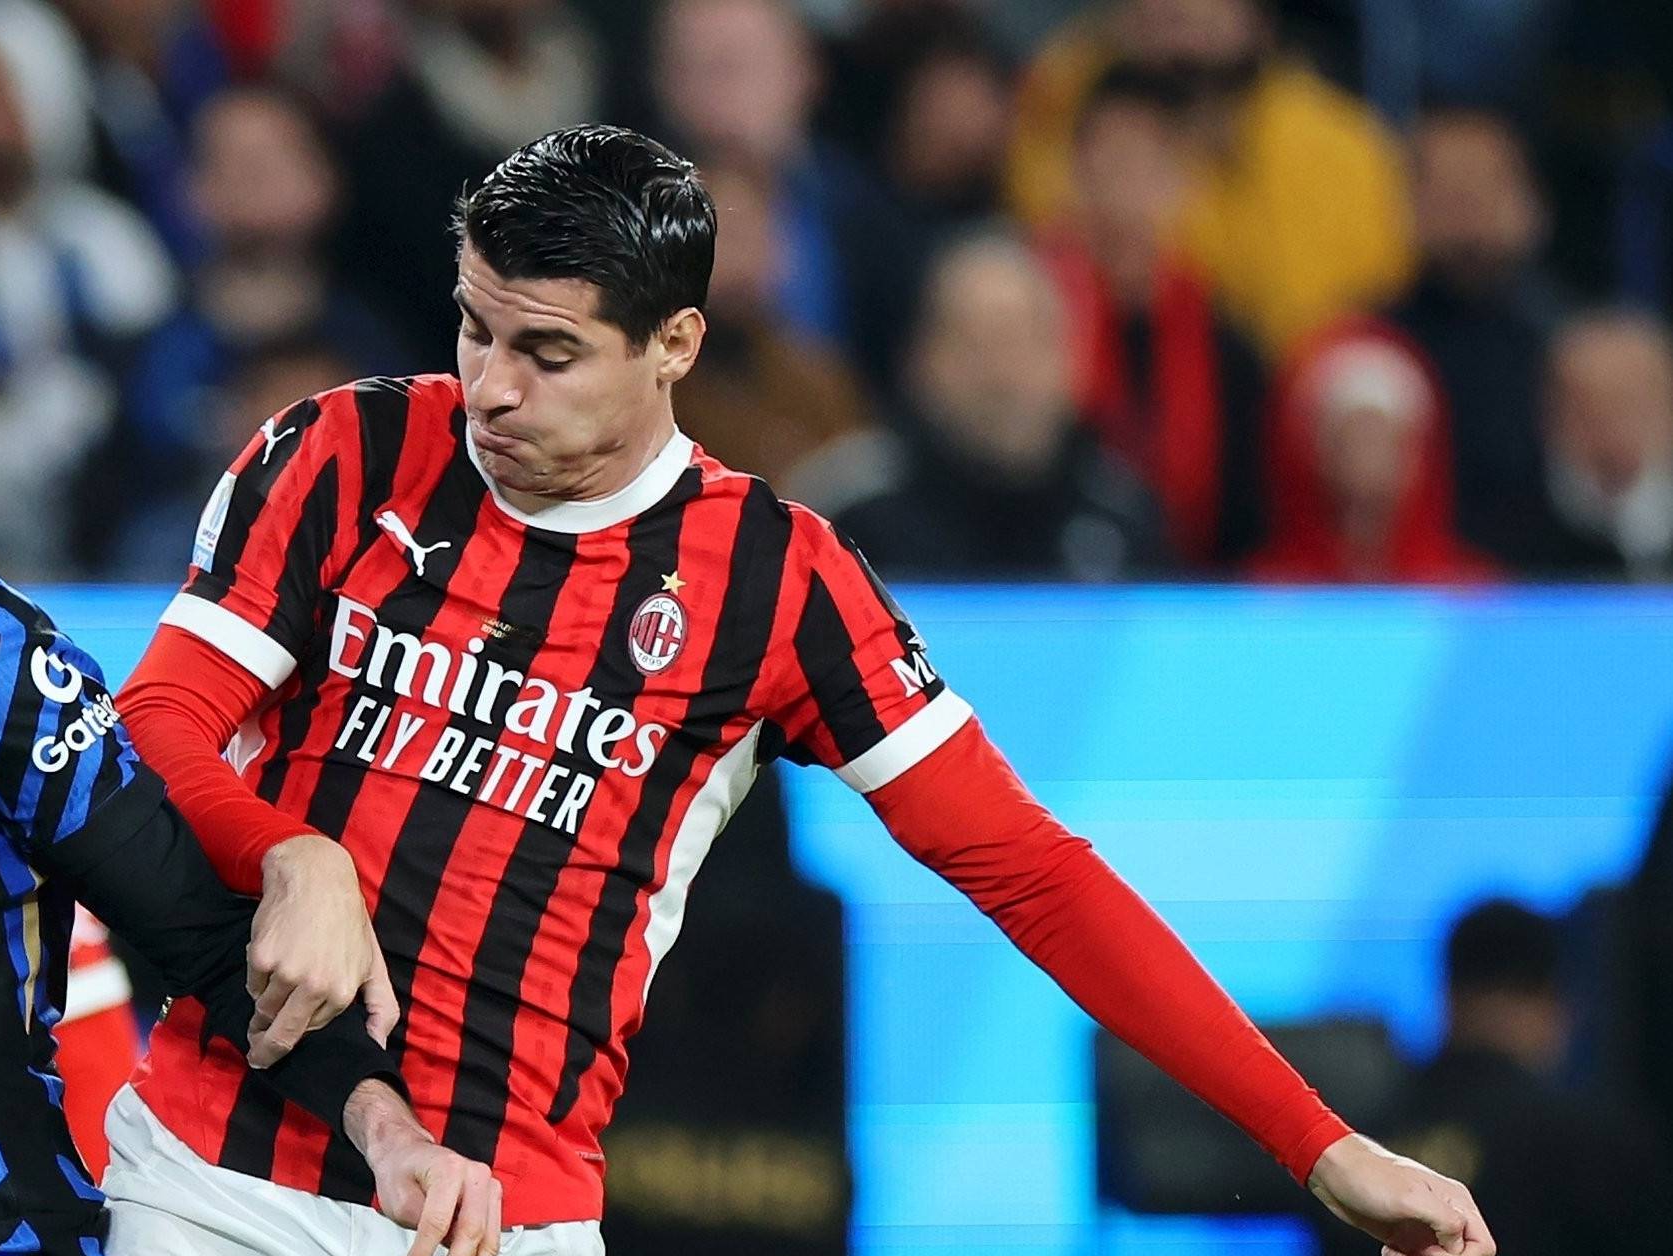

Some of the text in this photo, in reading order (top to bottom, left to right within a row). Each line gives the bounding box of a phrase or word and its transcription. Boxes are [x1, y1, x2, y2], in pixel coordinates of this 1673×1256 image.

[648, 600, 680, 619] ACM
[329, 595, 667, 777] Emirates
[637, 651, 663, 667] 1899
[335, 695, 596, 835] FLY BETTER
